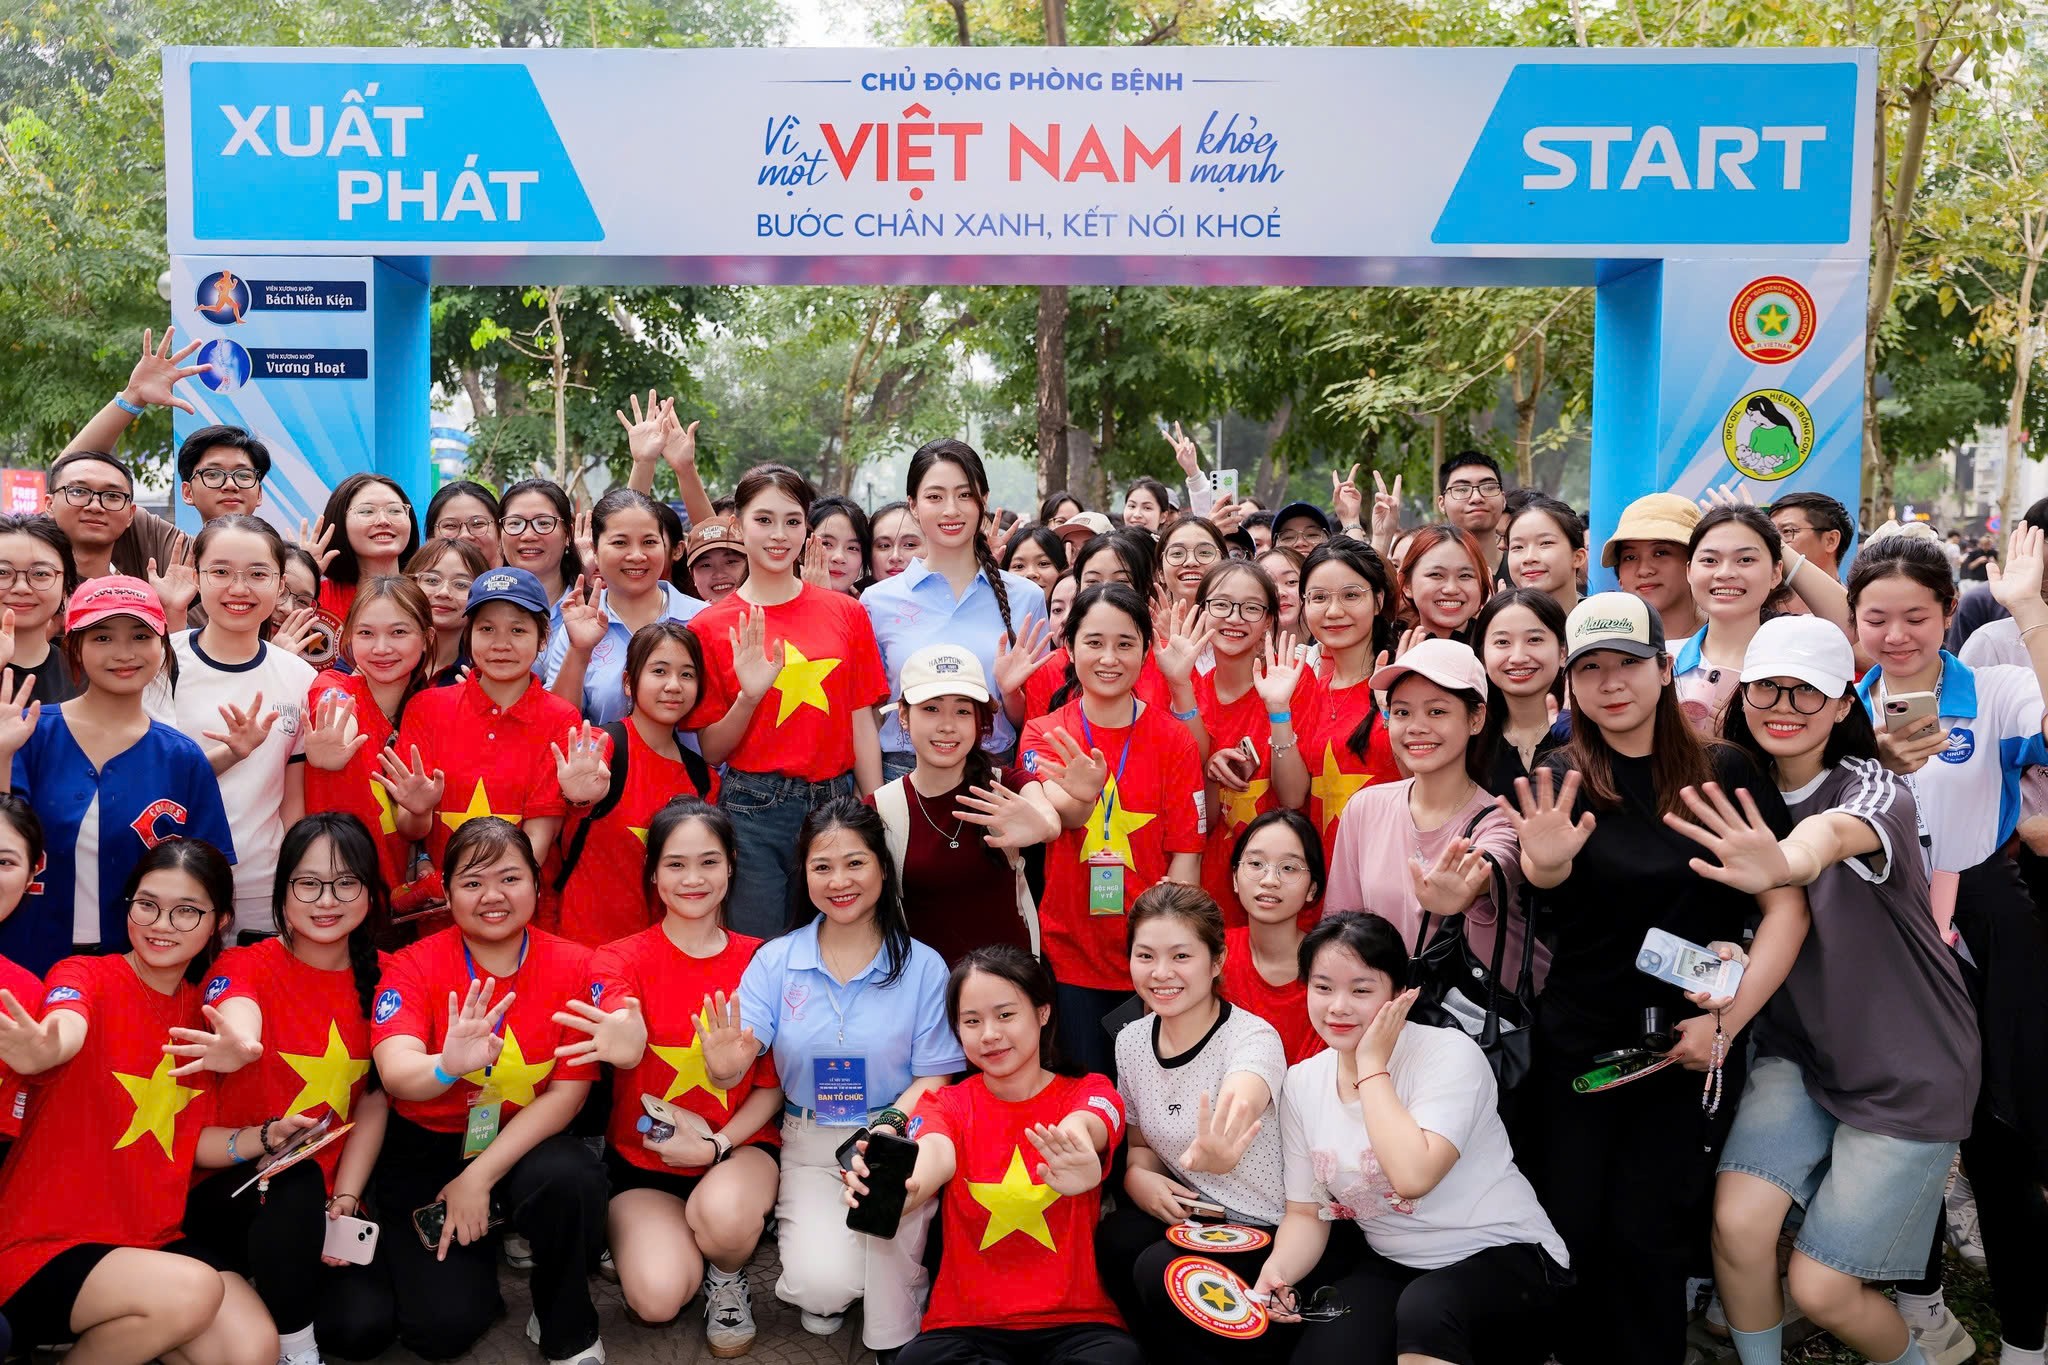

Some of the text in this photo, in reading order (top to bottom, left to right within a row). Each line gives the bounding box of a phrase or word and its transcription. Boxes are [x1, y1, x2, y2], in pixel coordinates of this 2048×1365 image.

[861, 66, 1183, 96] CHỦ ĐỘNG PHÒNG BỆNH
[219, 82, 424, 157] XUẤT
[765, 114, 800, 155] Vì
[1195, 110, 1274, 154] khỏe
[819, 102, 1182, 201] VIỆT NAM
[1190, 140, 1285, 192] mạnh
[1522, 125, 1826, 190] START
[338, 154, 539, 222] PHÁT
[758, 149, 828, 196] một
[757, 205, 1281, 240] BƯỚC CHÂN XANH, KẾT NỐI KHOẺ
[265, 293, 353, 309] Bách Niên Kiện
[265, 361, 346, 377] Vương Hoạt
[1726, 409, 1741, 440] OPC OIL
[1800, 437, 1811, 455] CON
[844, 1092, 864, 1101] CHỨC
